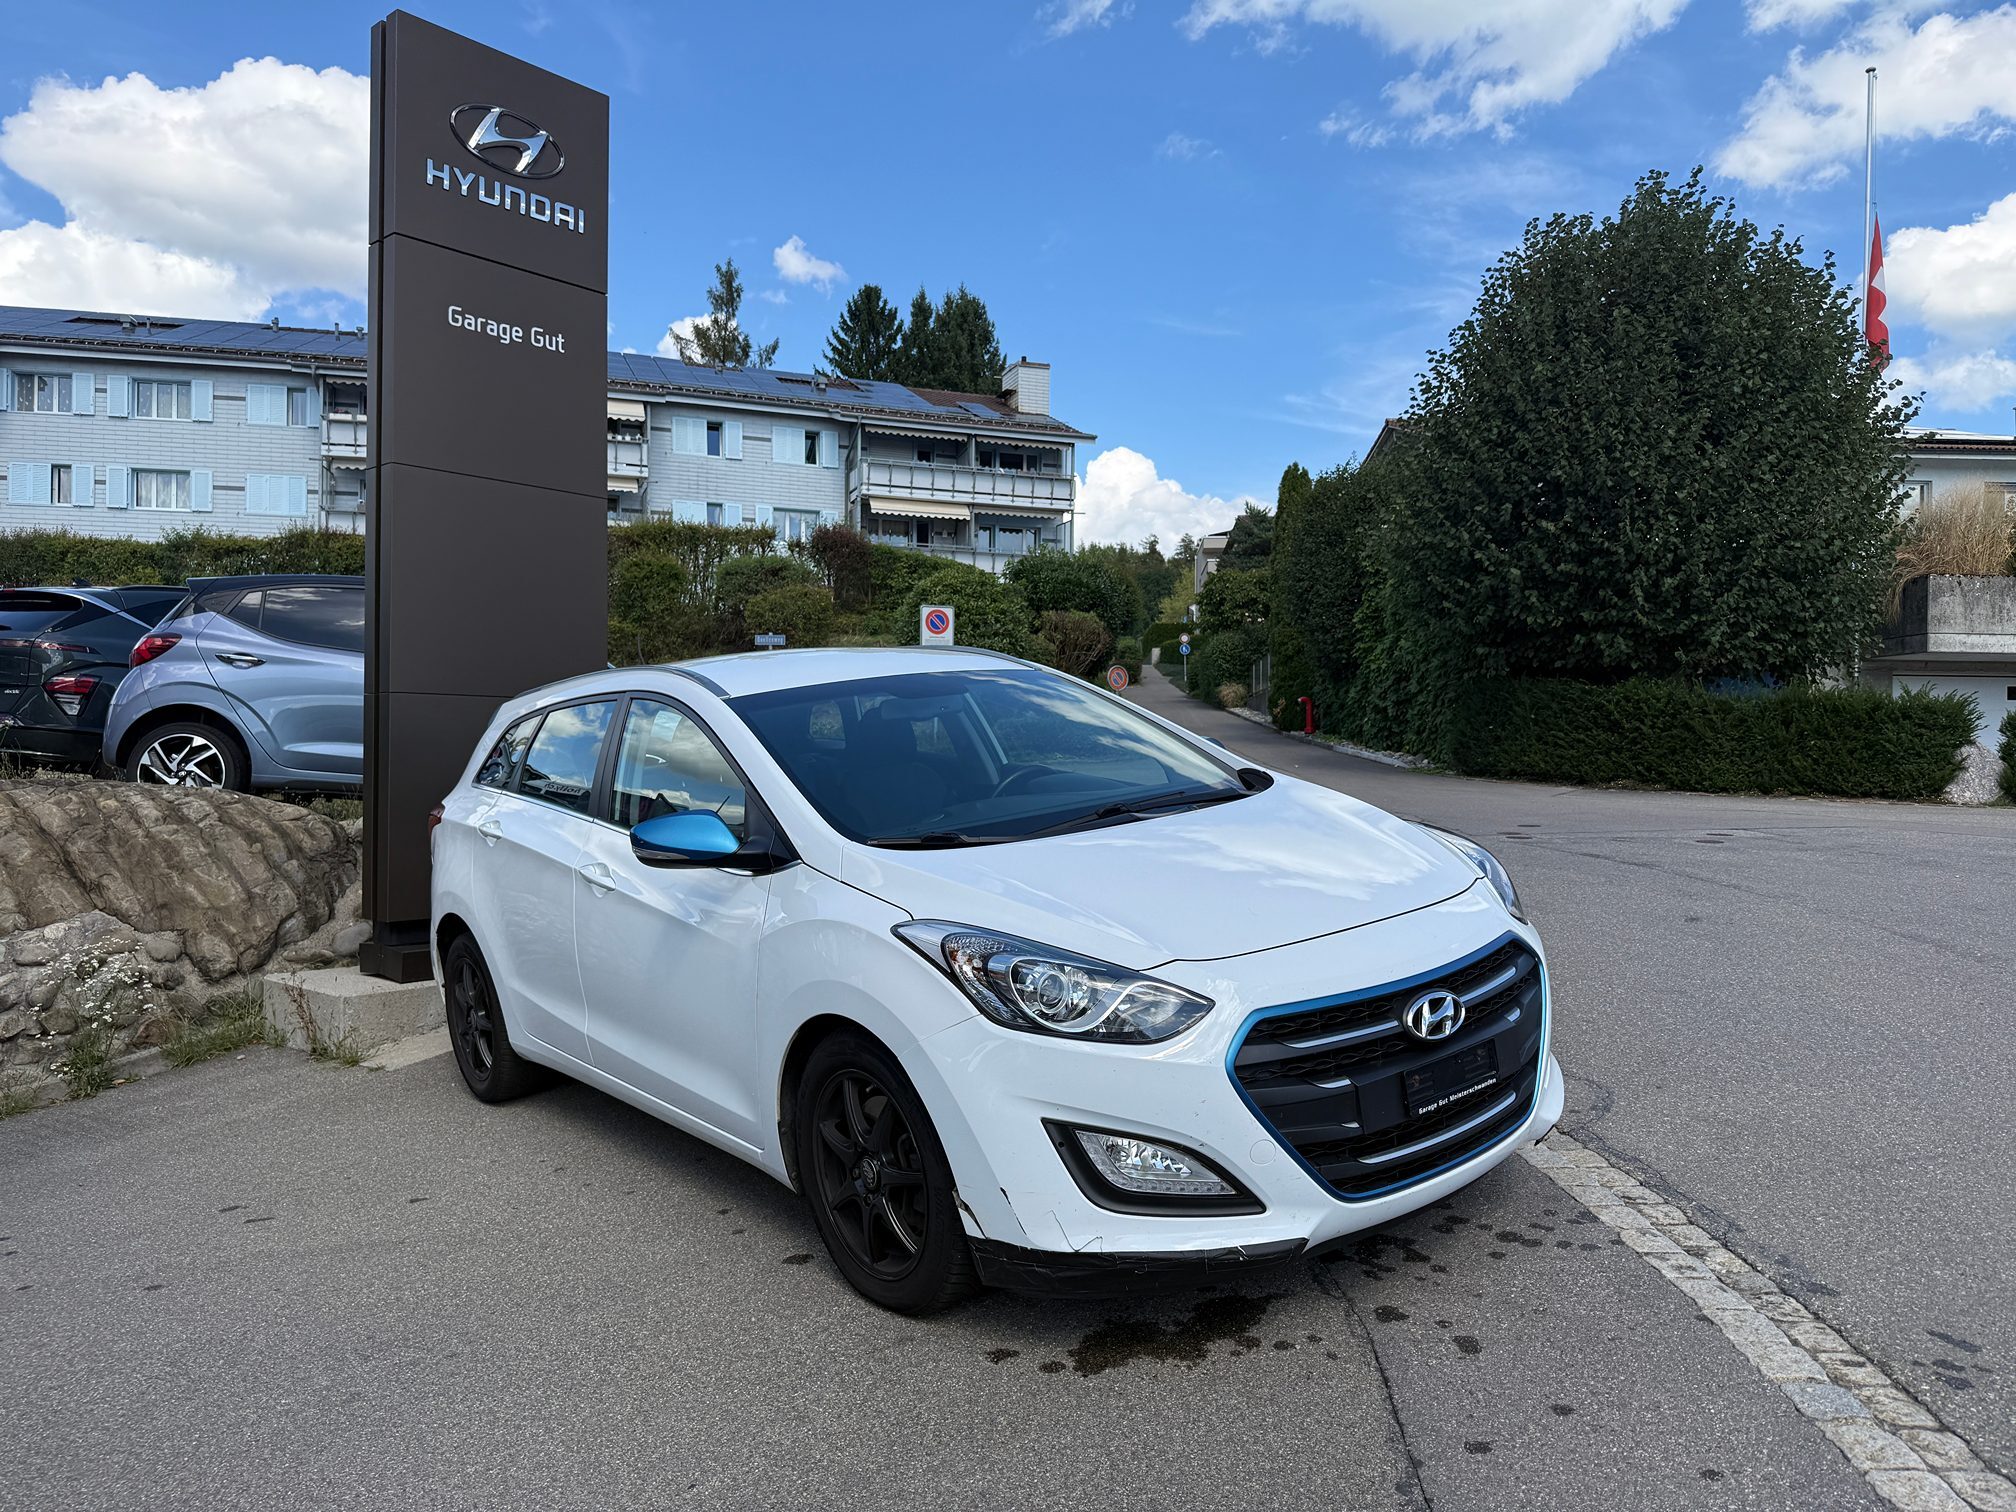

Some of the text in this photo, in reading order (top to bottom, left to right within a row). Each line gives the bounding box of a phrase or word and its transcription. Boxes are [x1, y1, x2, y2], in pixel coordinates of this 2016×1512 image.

[426, 158, 585, 234] HYUNDAI
[448, 305, 565, 353] Garage Gut
[1418, 1102, 1437, 1115] Garage
[1438, 1097, 1449, 1106] Gut
